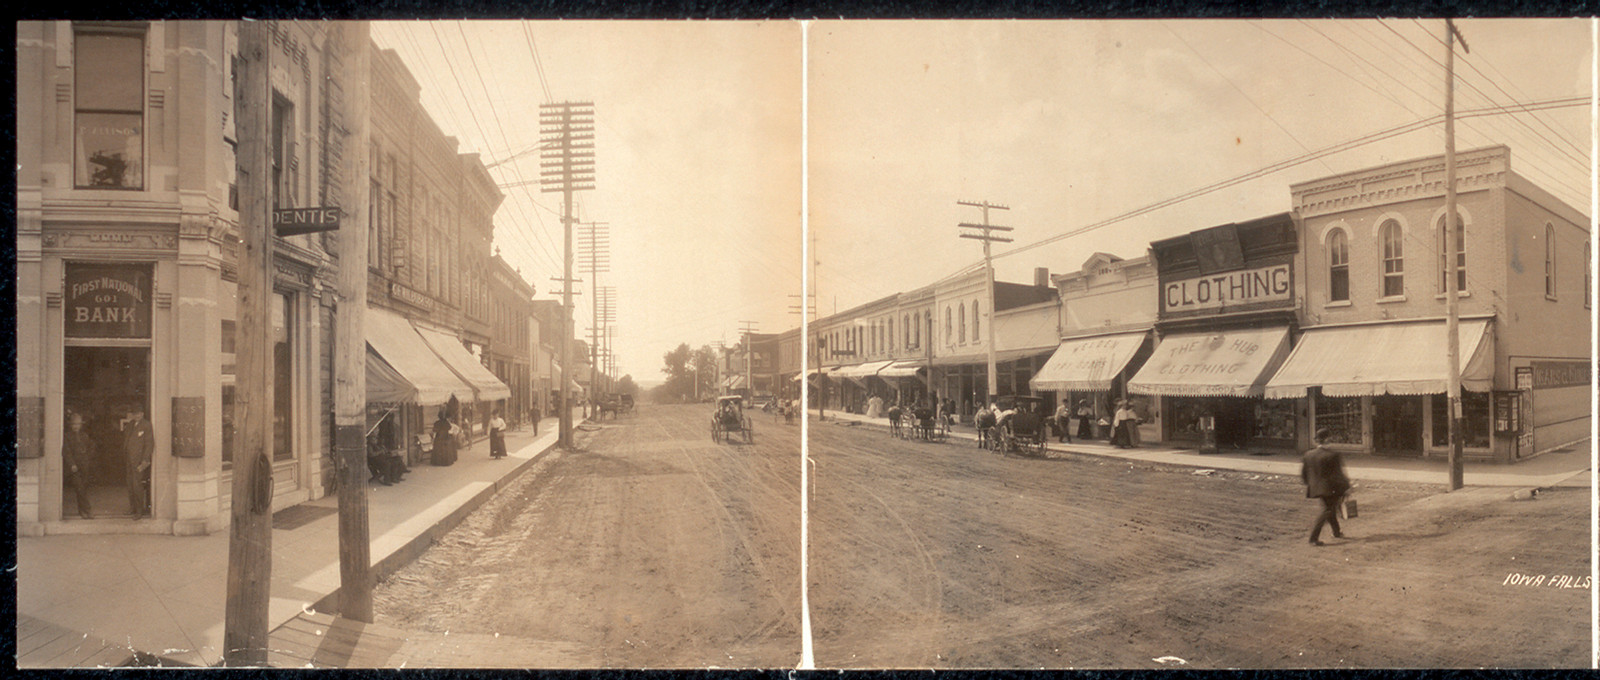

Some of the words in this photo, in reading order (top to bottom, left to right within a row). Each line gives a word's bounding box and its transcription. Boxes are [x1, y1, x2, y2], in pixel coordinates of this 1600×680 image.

[273, 209, 338, 224] DENTIS
[72, 280, 100, 299] FIRST
[101, 277, 143, 303] NATIONAL
[1167, 267, 1289, 307] CLOTHING
[95, 295, 117, 303] 601
[1169, 341, 1200, 358] THE
[1231, 338, 1260, 356] HUB
[1158, 363, 1241, 376] CLOTHING
